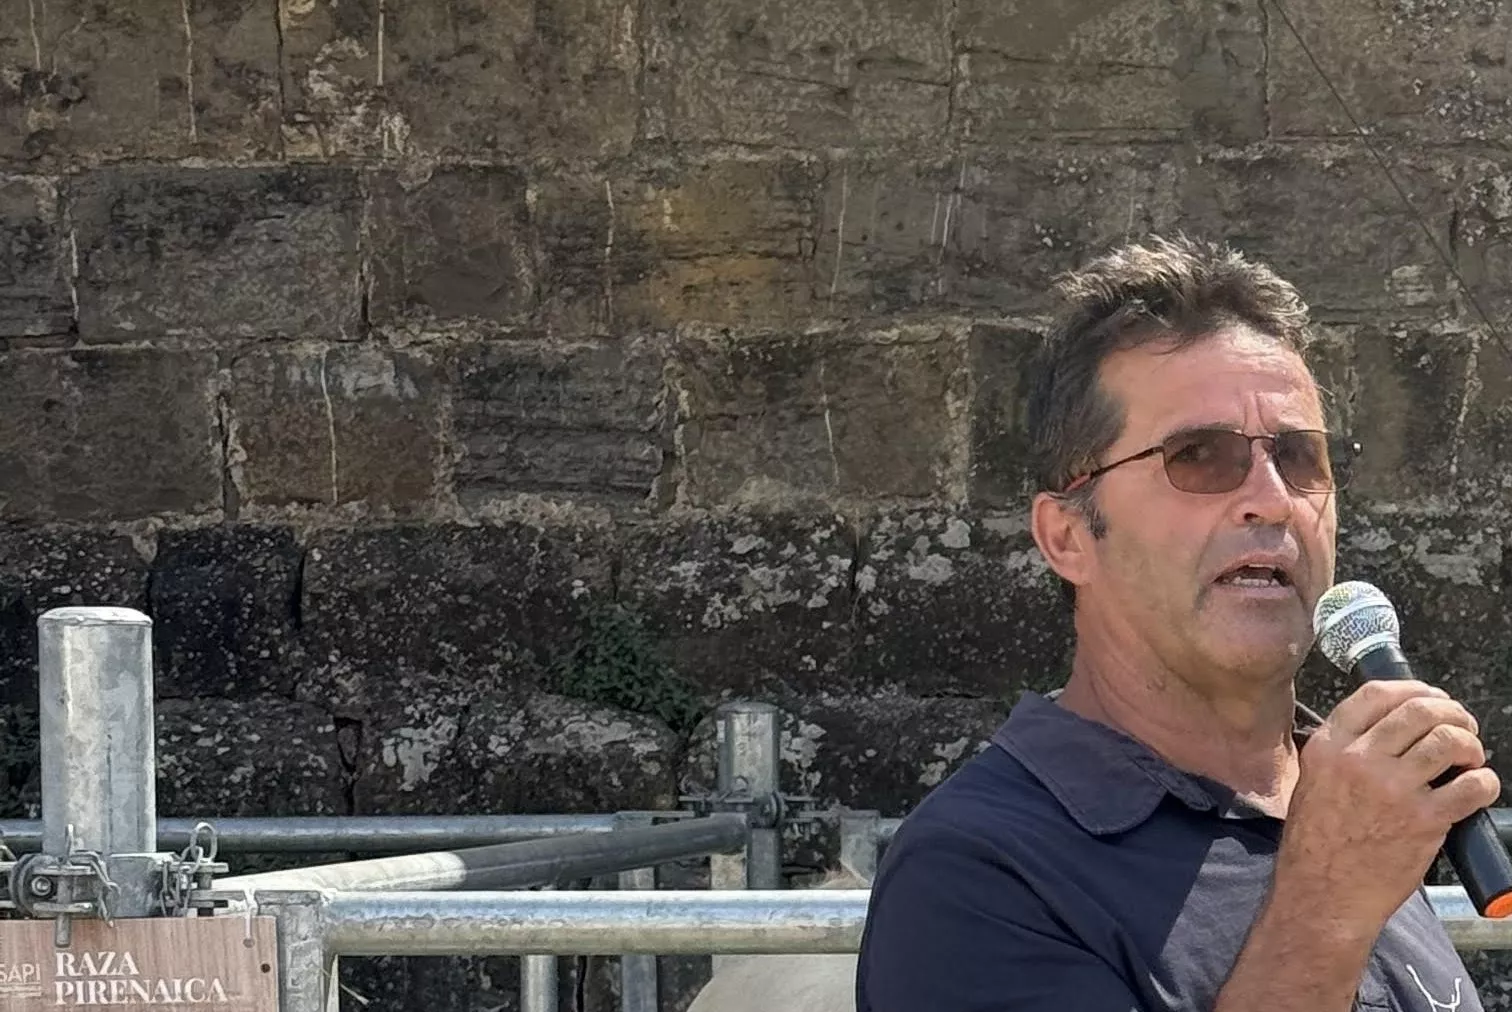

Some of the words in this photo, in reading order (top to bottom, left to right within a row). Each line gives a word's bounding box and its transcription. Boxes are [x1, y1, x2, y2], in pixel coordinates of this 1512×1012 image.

[0, 963, 41, 983] SAPI
[55, 951, 139, 977] RAZA
[55, 977, 229, 1005] PIRENAICA
